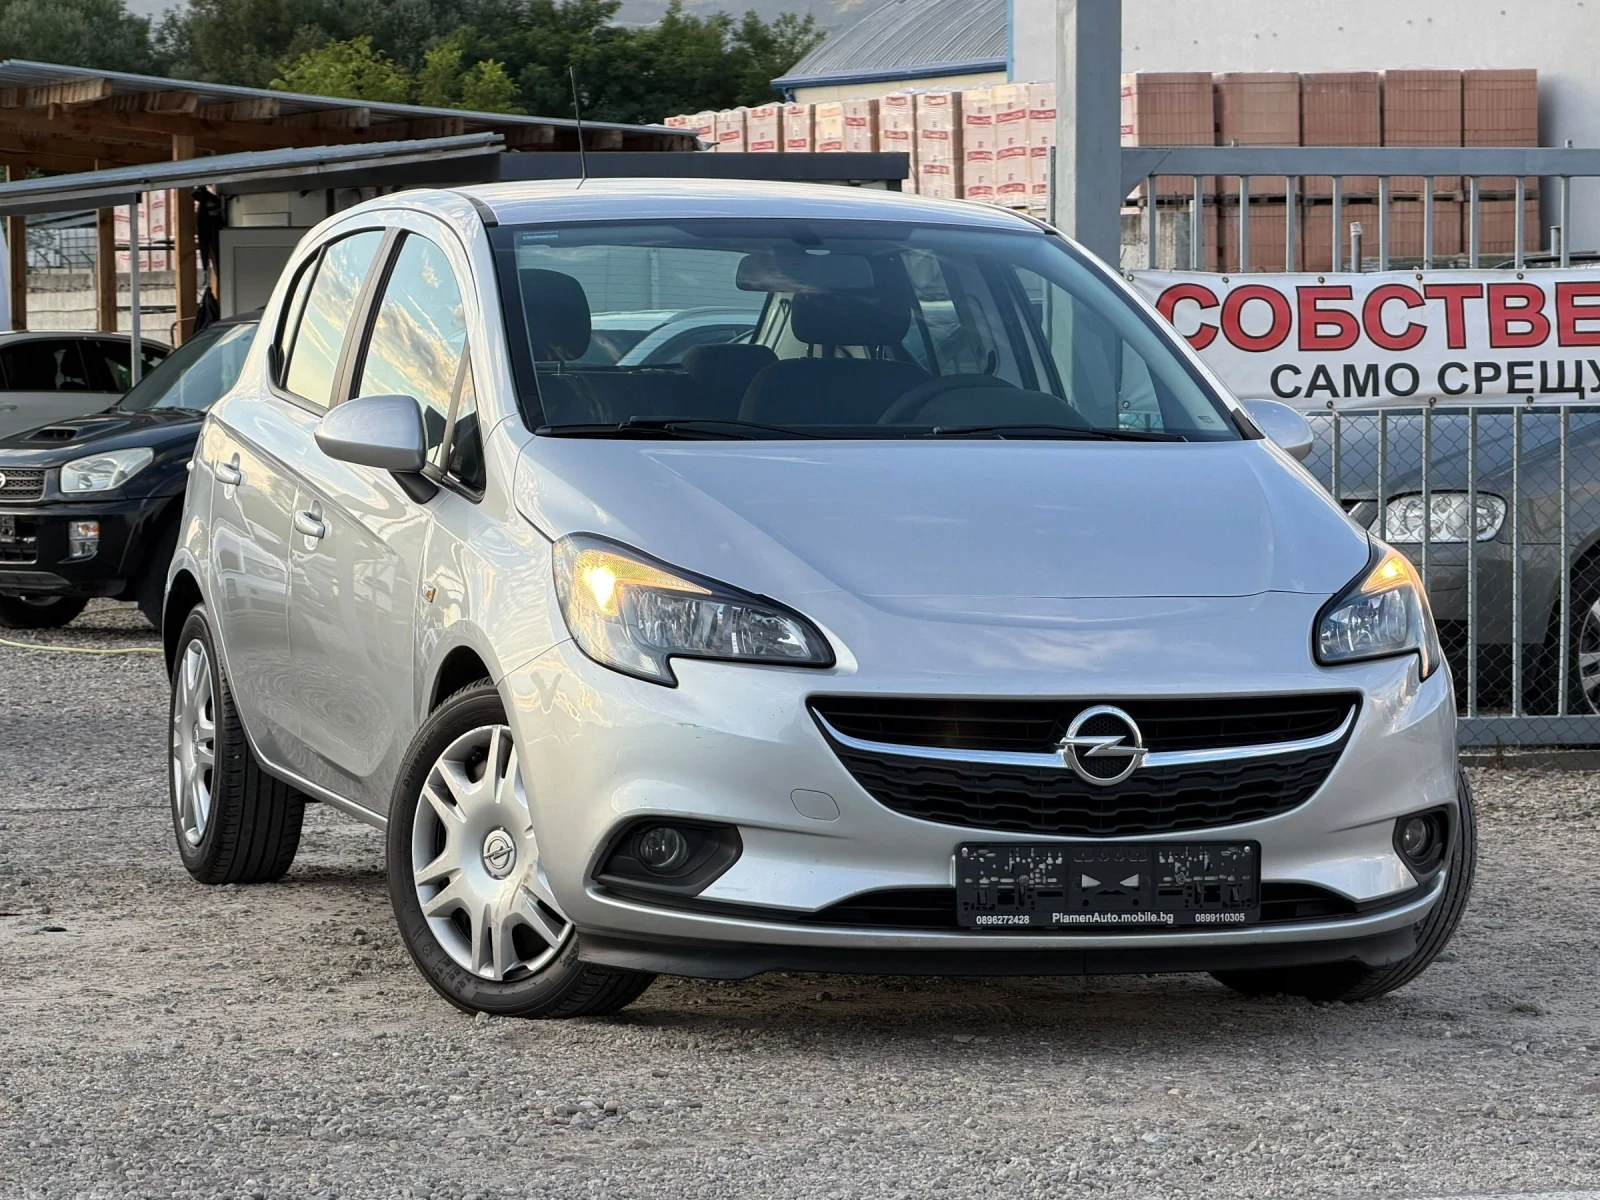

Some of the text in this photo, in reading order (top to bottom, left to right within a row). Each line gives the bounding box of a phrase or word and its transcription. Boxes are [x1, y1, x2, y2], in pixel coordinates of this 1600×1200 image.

[1156, 282, 1600, 352] СОБСТВЕ
[1270, 362, 1420, 398] САМО
[976, 912, 1245, 925] 0896272428 PlamenAuto.mobile.bg 0899110305
